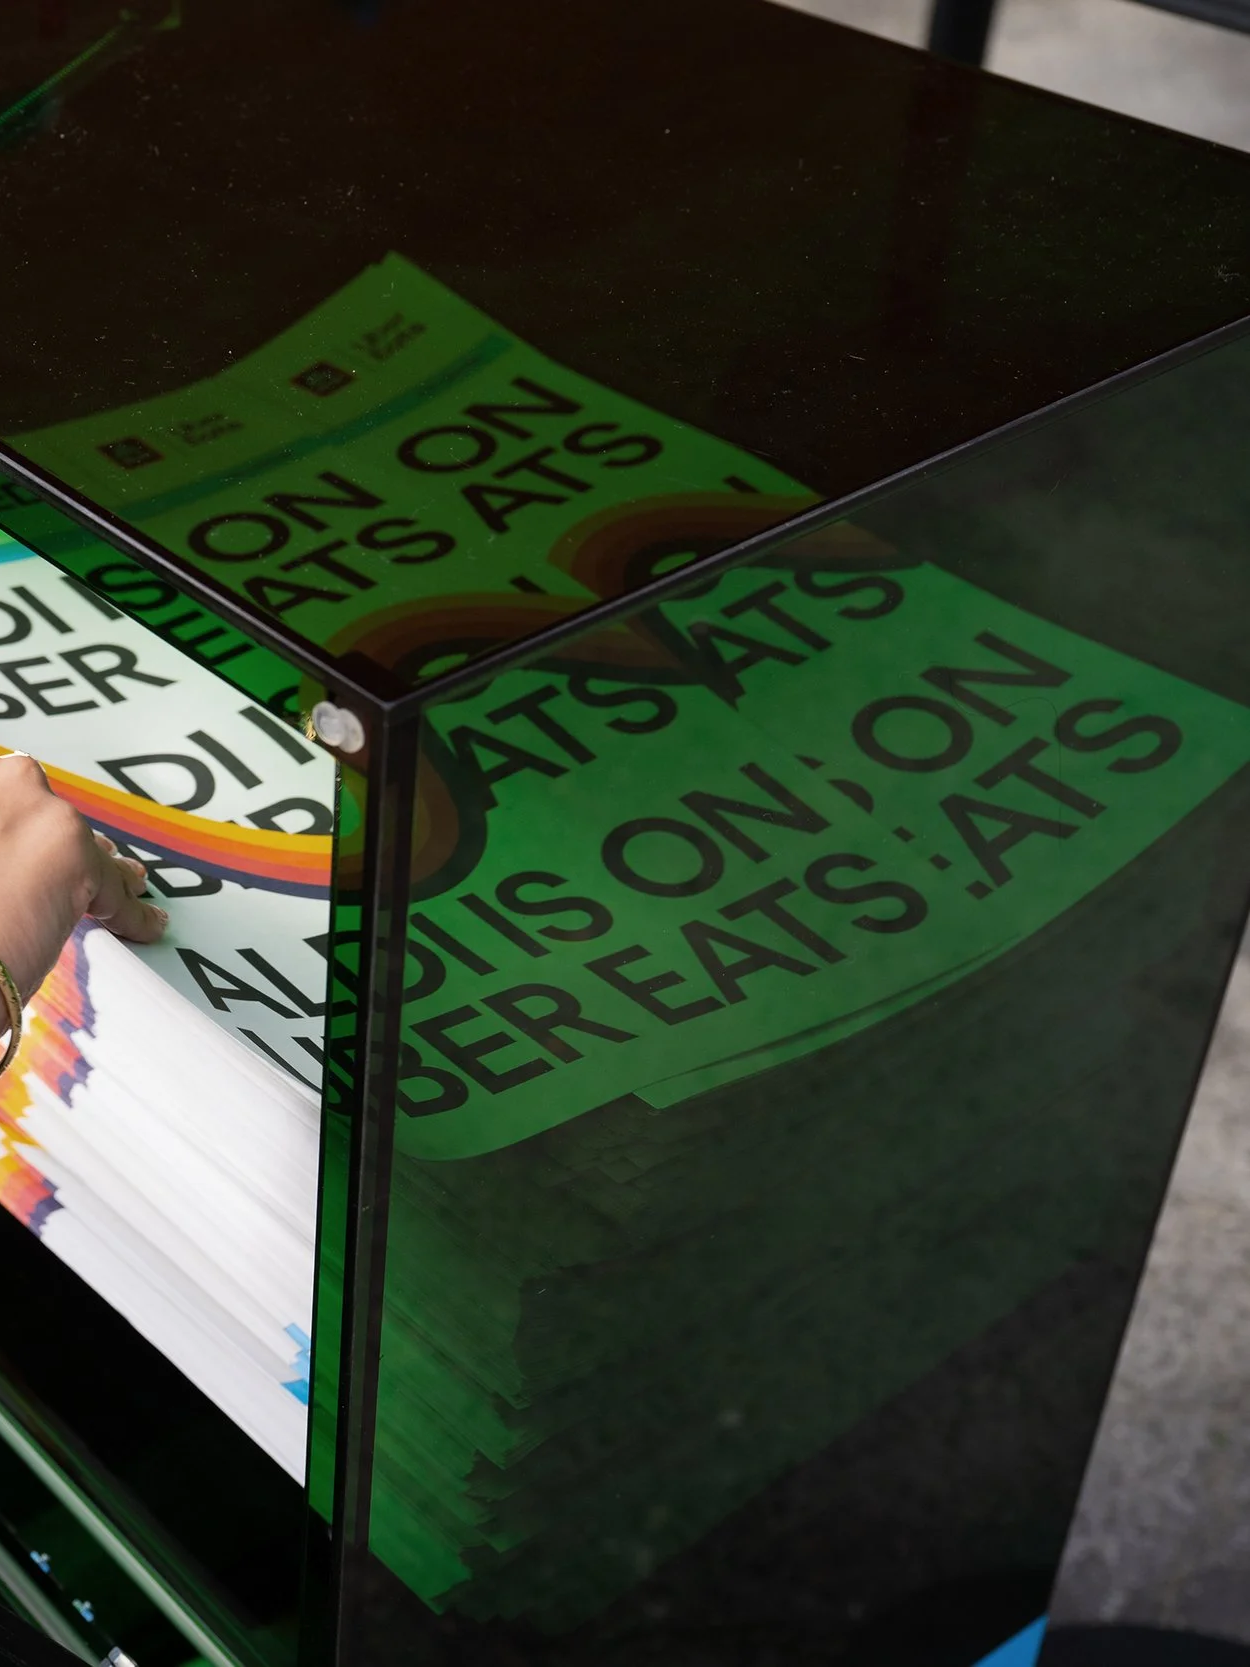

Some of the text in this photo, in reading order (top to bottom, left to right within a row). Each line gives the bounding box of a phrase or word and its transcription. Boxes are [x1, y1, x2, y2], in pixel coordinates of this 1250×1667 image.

[396, 377, 584, 473] ON
[460, 422, 664, 534] ATS
[188, 471, 386, 562] ON
[687, 570, 905, 696] ATS
[448, 676, 678, 811] ATS
[851, 630, 1073, 774] ON
[96, 730, 263, 813] DI
[939, 698, 1183, 890] ATS
[457, 871, 613, 958] IS
[601, 761, 833, 898] ON
[585, 853, 929, 1026] EATS
